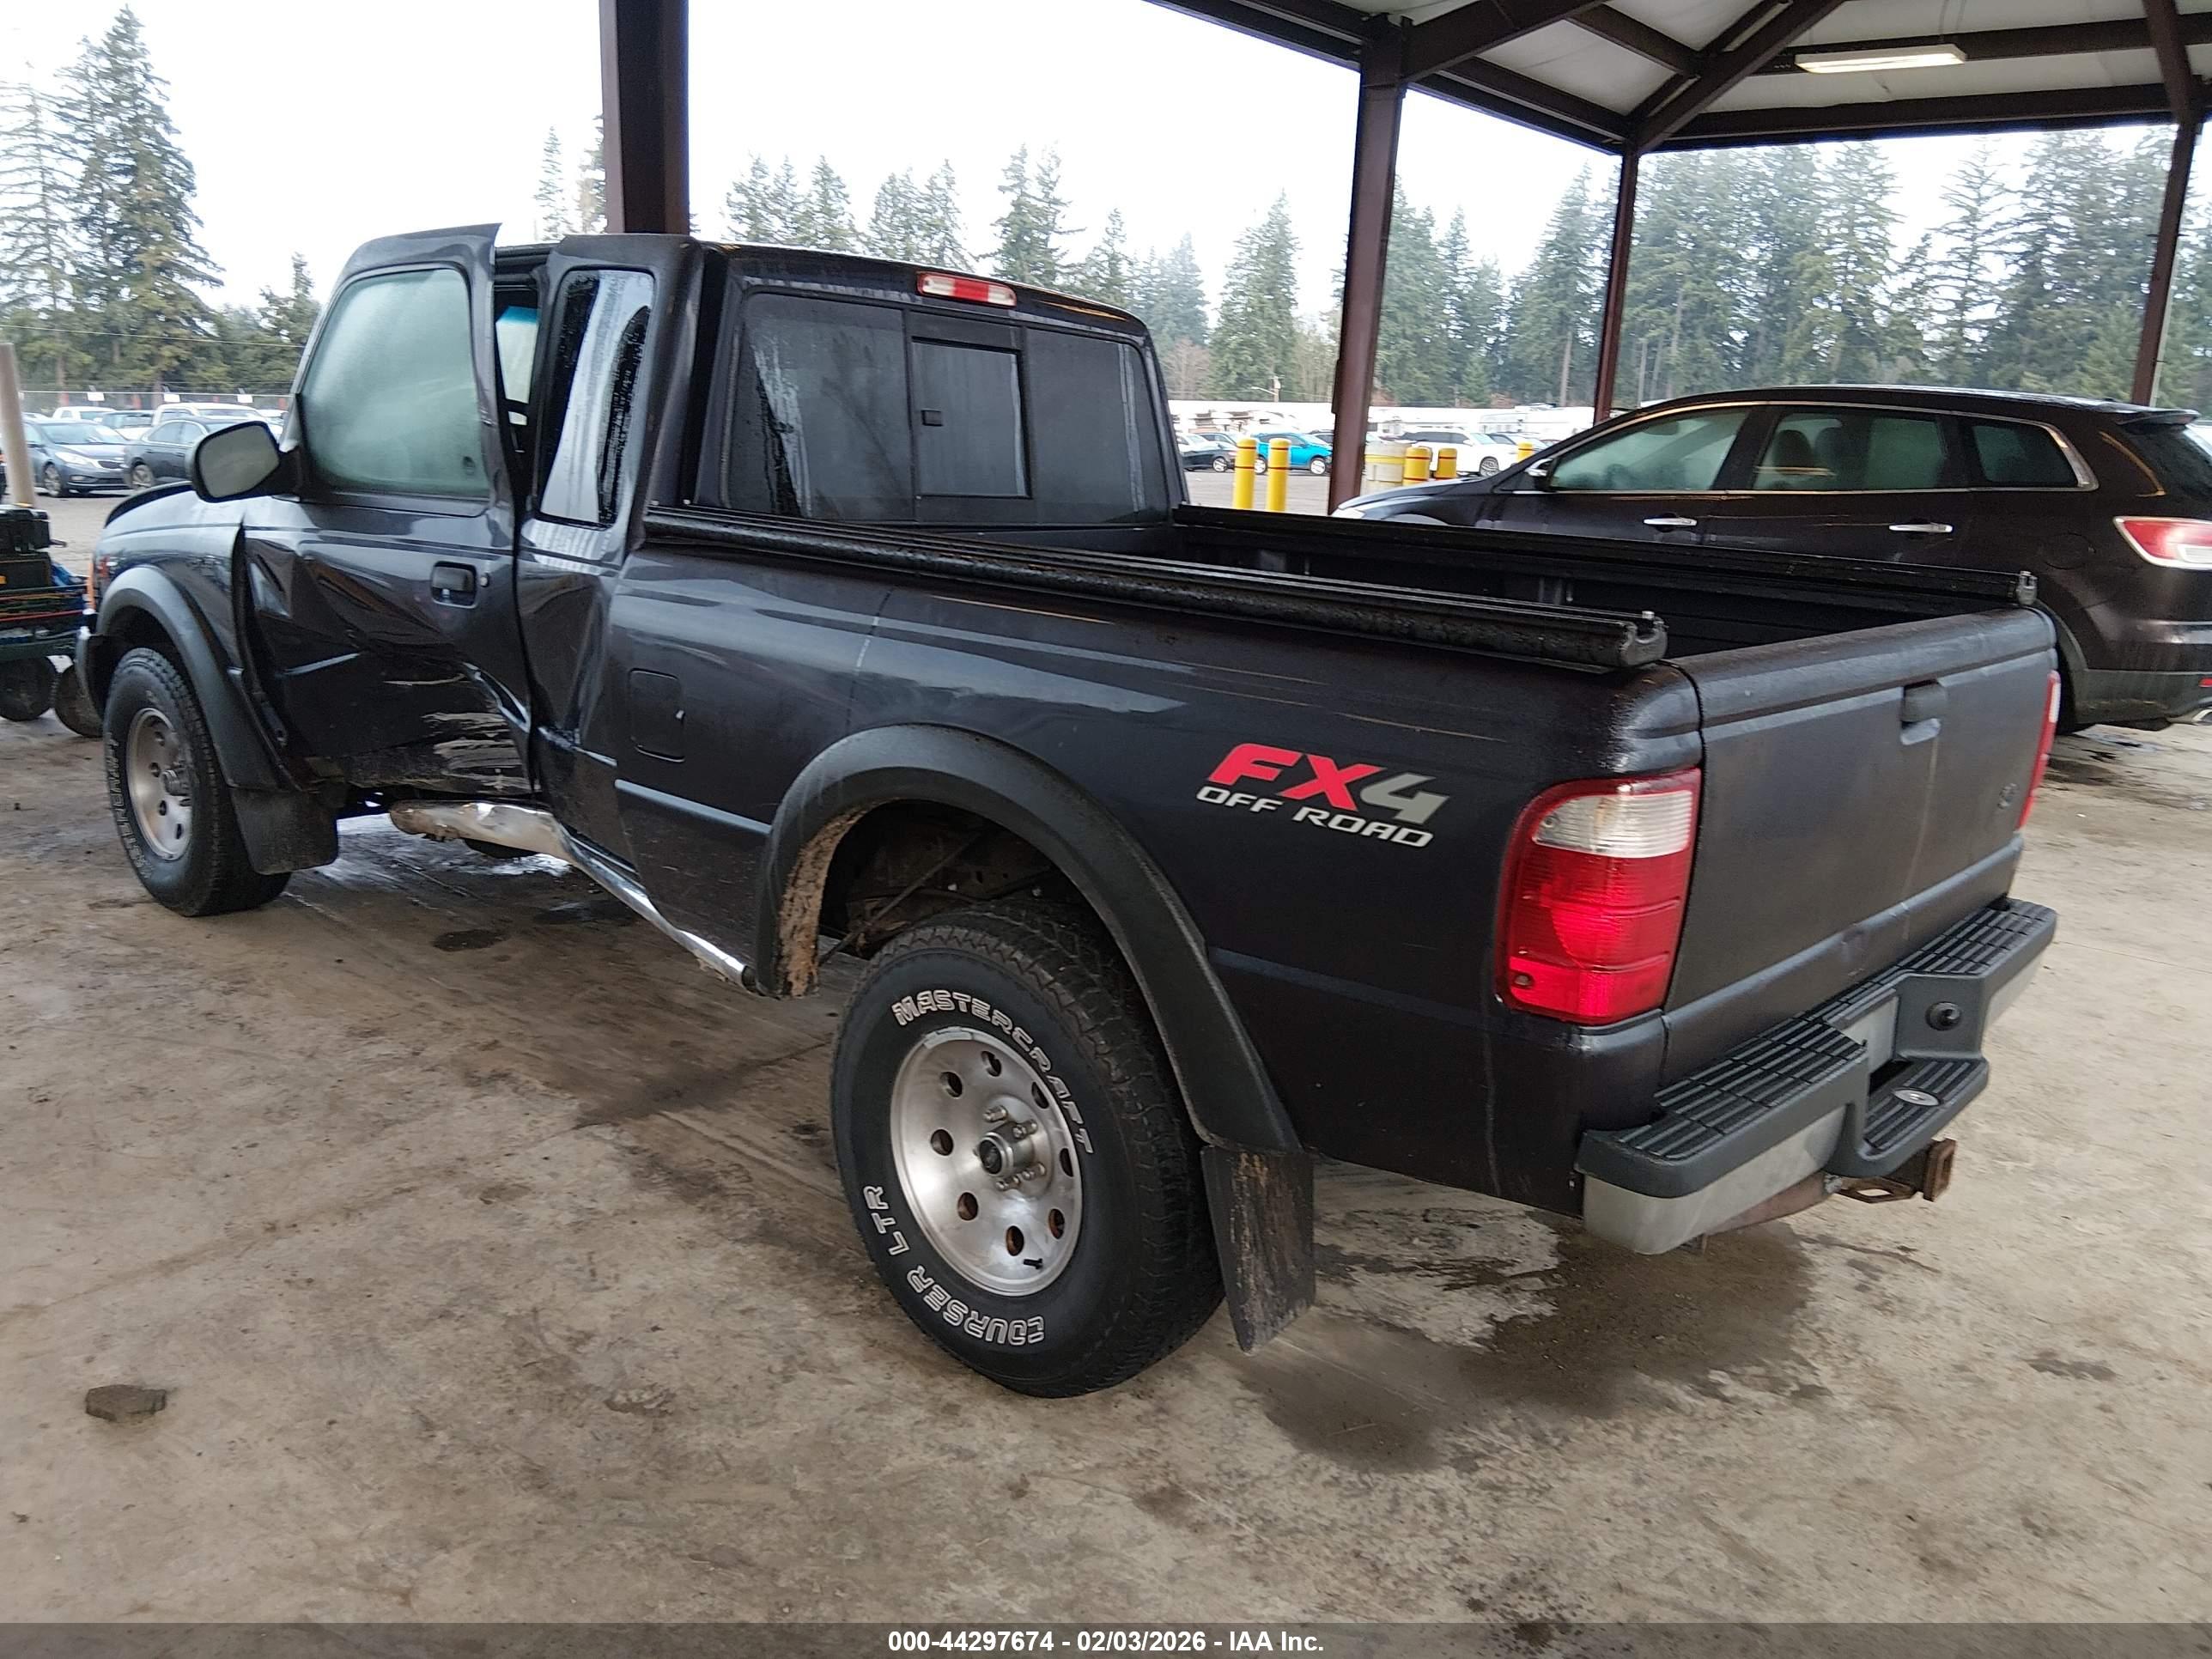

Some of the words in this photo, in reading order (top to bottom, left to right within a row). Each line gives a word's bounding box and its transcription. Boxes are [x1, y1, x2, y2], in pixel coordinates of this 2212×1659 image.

[1195, 785, 1285, 814] OFF
[1291, 805, 1435, 848] ROAD
[1207, 742, 1449, 824] FX4
[891, 989, 1094, 1154] MASTERCRAFT
[863, 1185, 909, 1256] LTR
[906, 1264, 1045, 1346] COURSER
